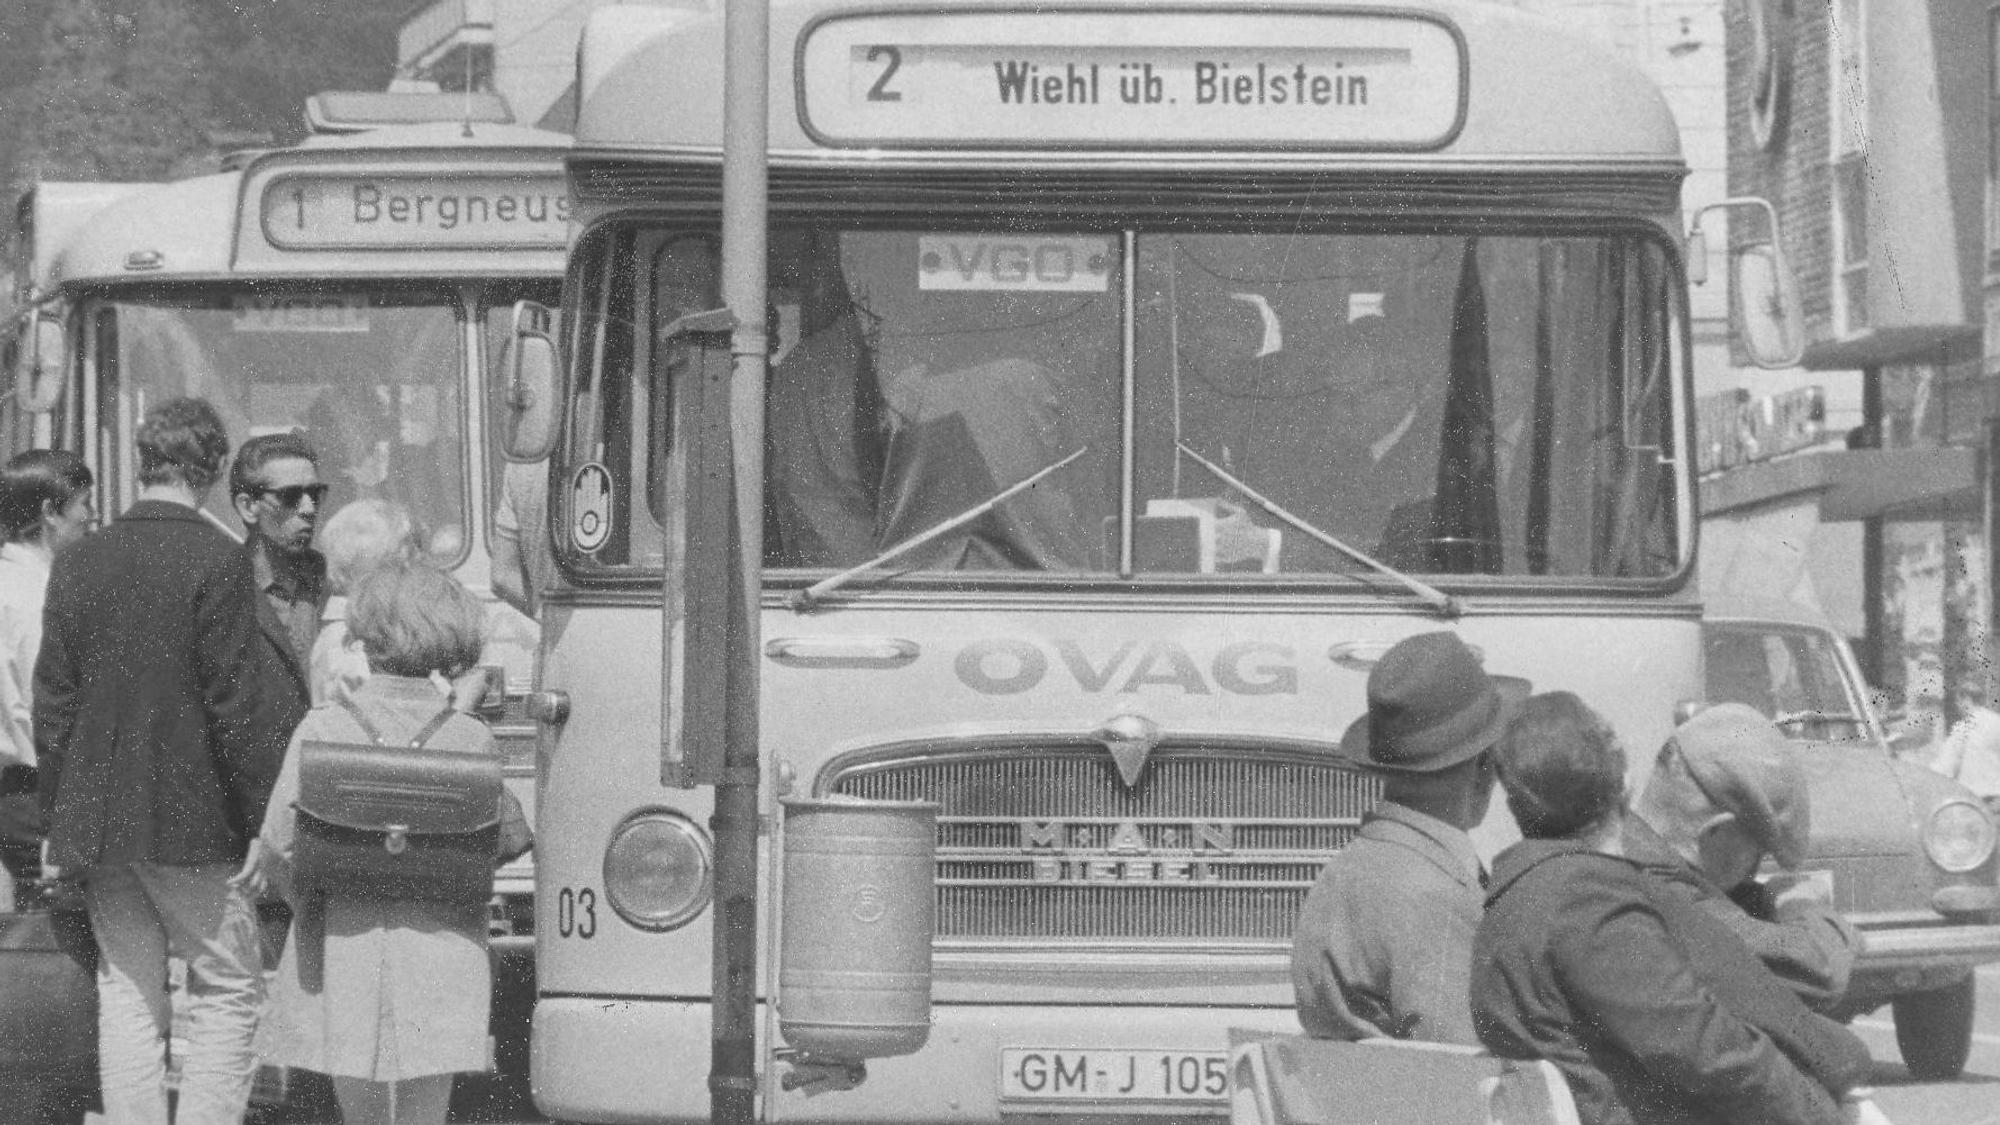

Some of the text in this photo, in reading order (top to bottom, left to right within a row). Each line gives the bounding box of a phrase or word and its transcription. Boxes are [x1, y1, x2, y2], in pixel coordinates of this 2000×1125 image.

[866, 44, 1368, 105] 2 Wiehl üb. Bielstein
[293, 185, 304, 231] 1
[949, 243, 1074, 283] VGO
[953, 637, 1298, 696] OVAG
[1032, 858, 1220, 884] DIESEL
[558, 886, 597, 939] 03
[1161, 1055, 1228, 1096] 105
